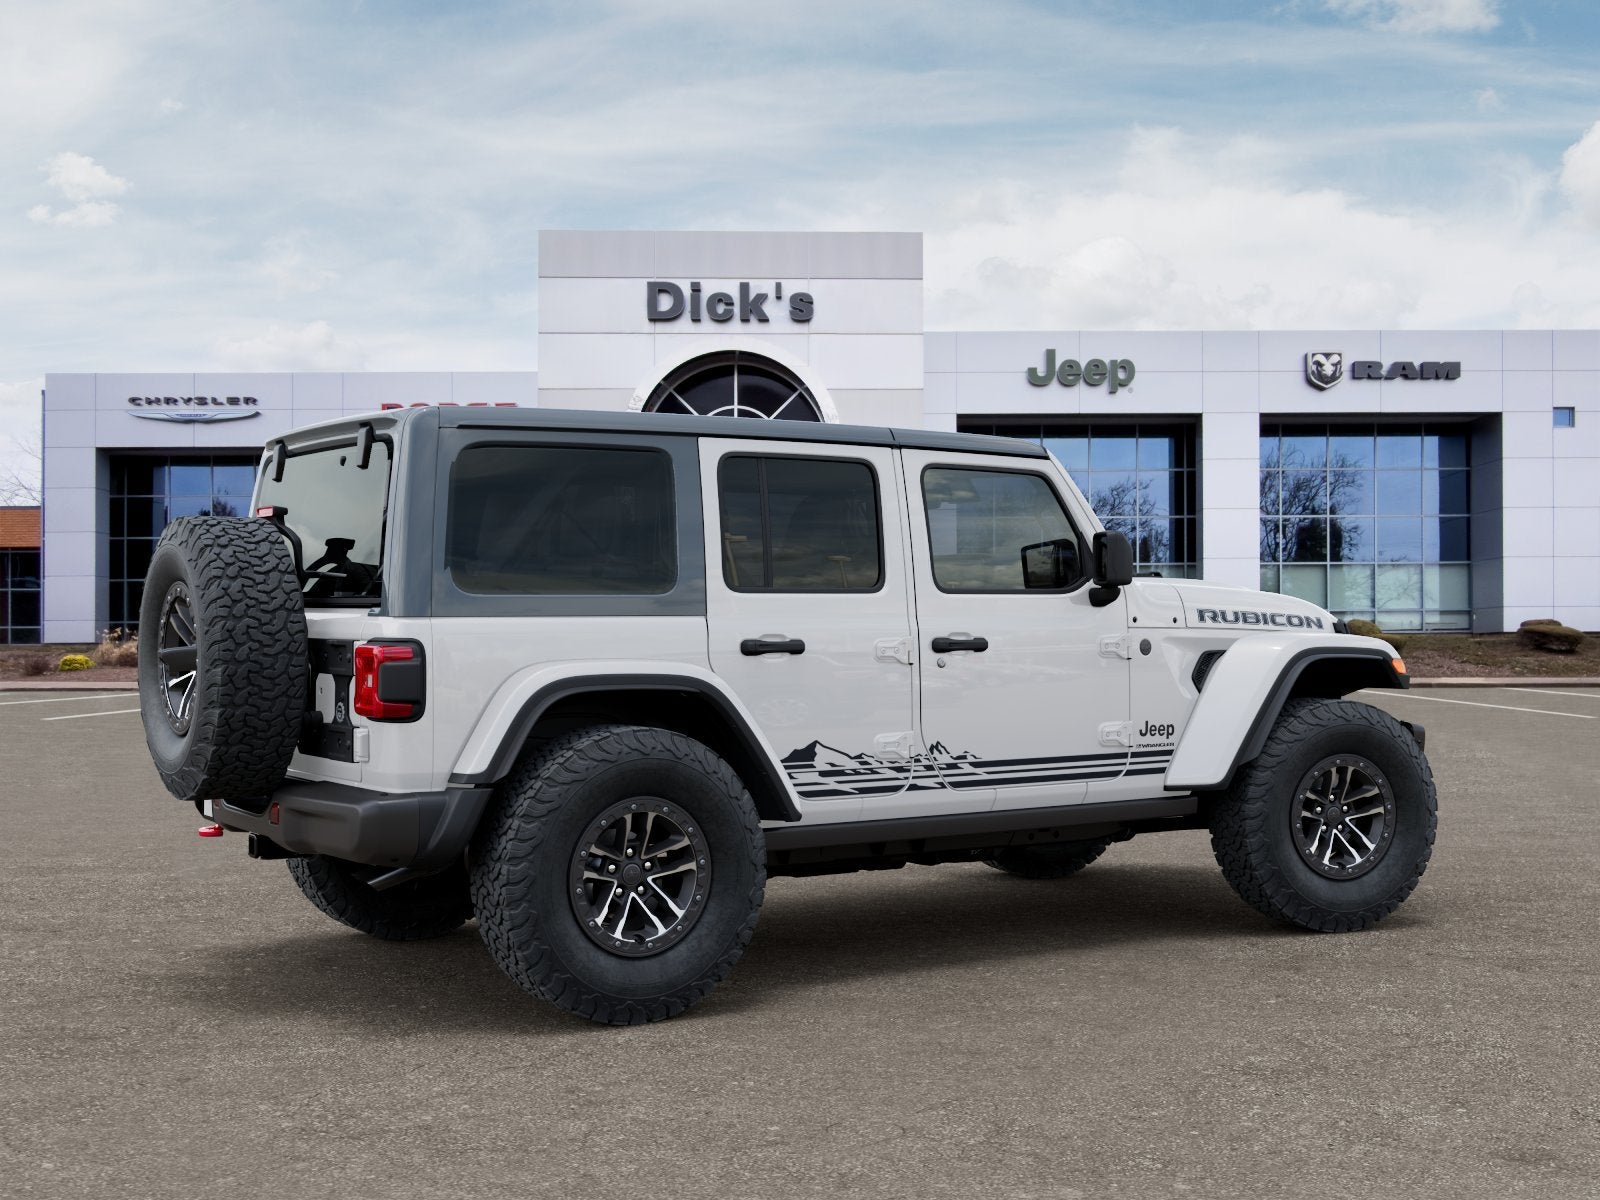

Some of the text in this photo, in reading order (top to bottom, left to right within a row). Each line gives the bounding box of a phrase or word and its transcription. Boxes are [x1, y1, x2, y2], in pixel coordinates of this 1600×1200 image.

[647, 281, 814, 322] Dick's
[1027, 348, 1136, 394] Jeep
[1352, 360, 1461, 380] RAM
[127, 396, 258, 406] CHRYSLER
[1197, 608, 1324, 629] RUBICON
[1139, 720, 1175, 739] Jeep
